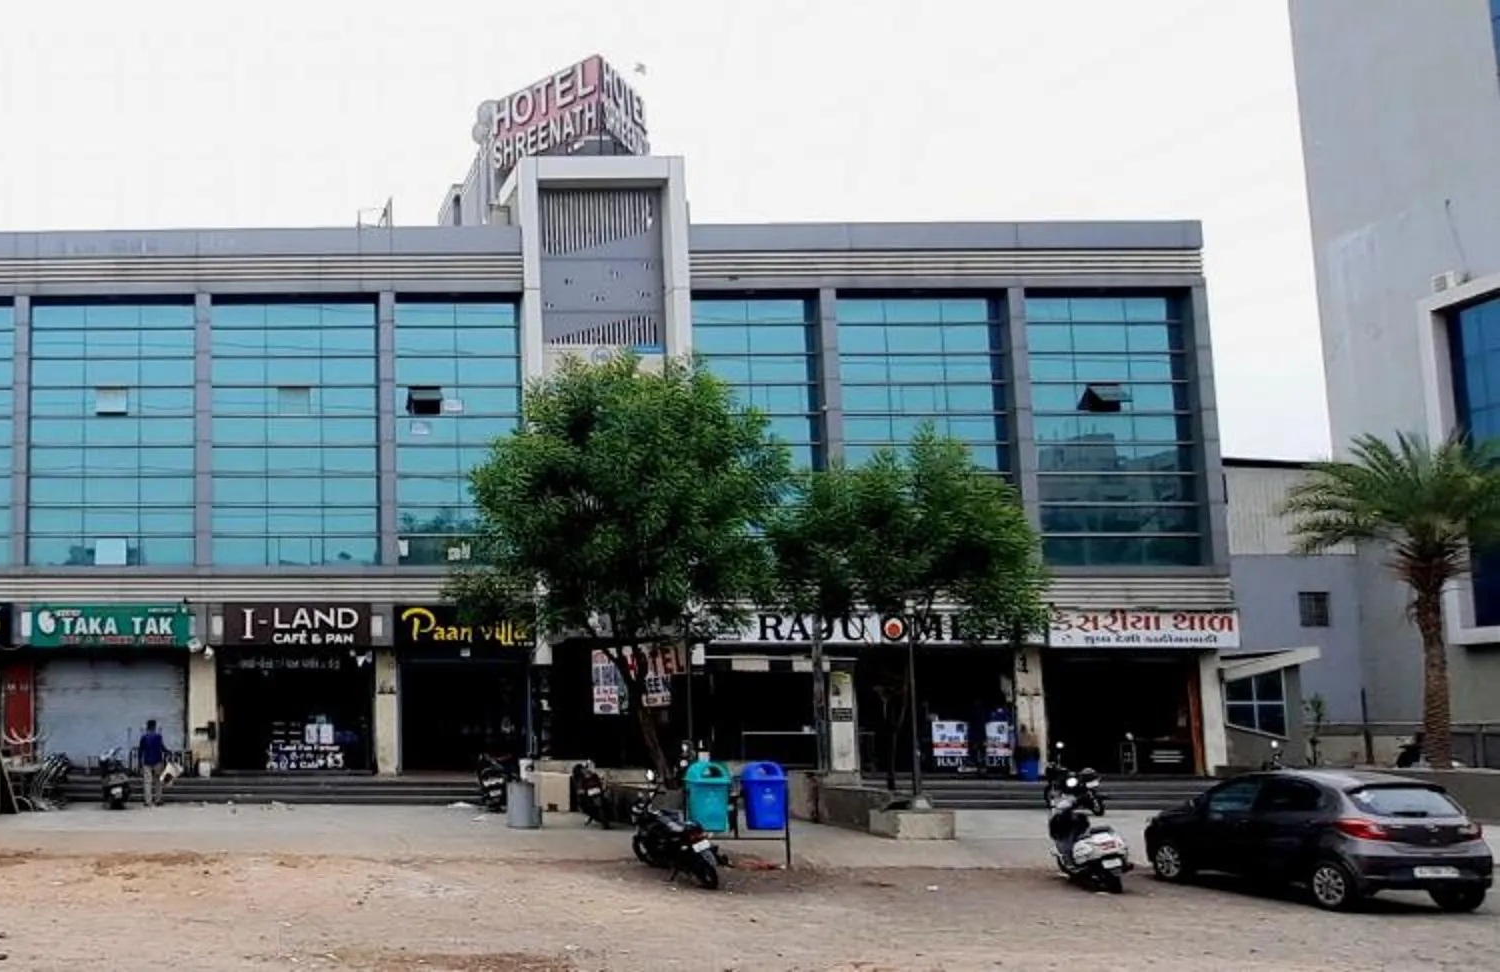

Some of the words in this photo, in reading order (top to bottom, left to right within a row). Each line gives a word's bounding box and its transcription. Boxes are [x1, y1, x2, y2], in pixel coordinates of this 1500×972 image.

[493, 62, 597, 136] HOTEL
[493, 99, 601, 171] SHREENATH
[63, 617, 119, 635] TAKA
[131, 617, 174, 635] TAK
[243, 607, 359, 639] I-LAND
[325, 633, 354, 644] PAN
[401, 607, 472, 643] Paan
